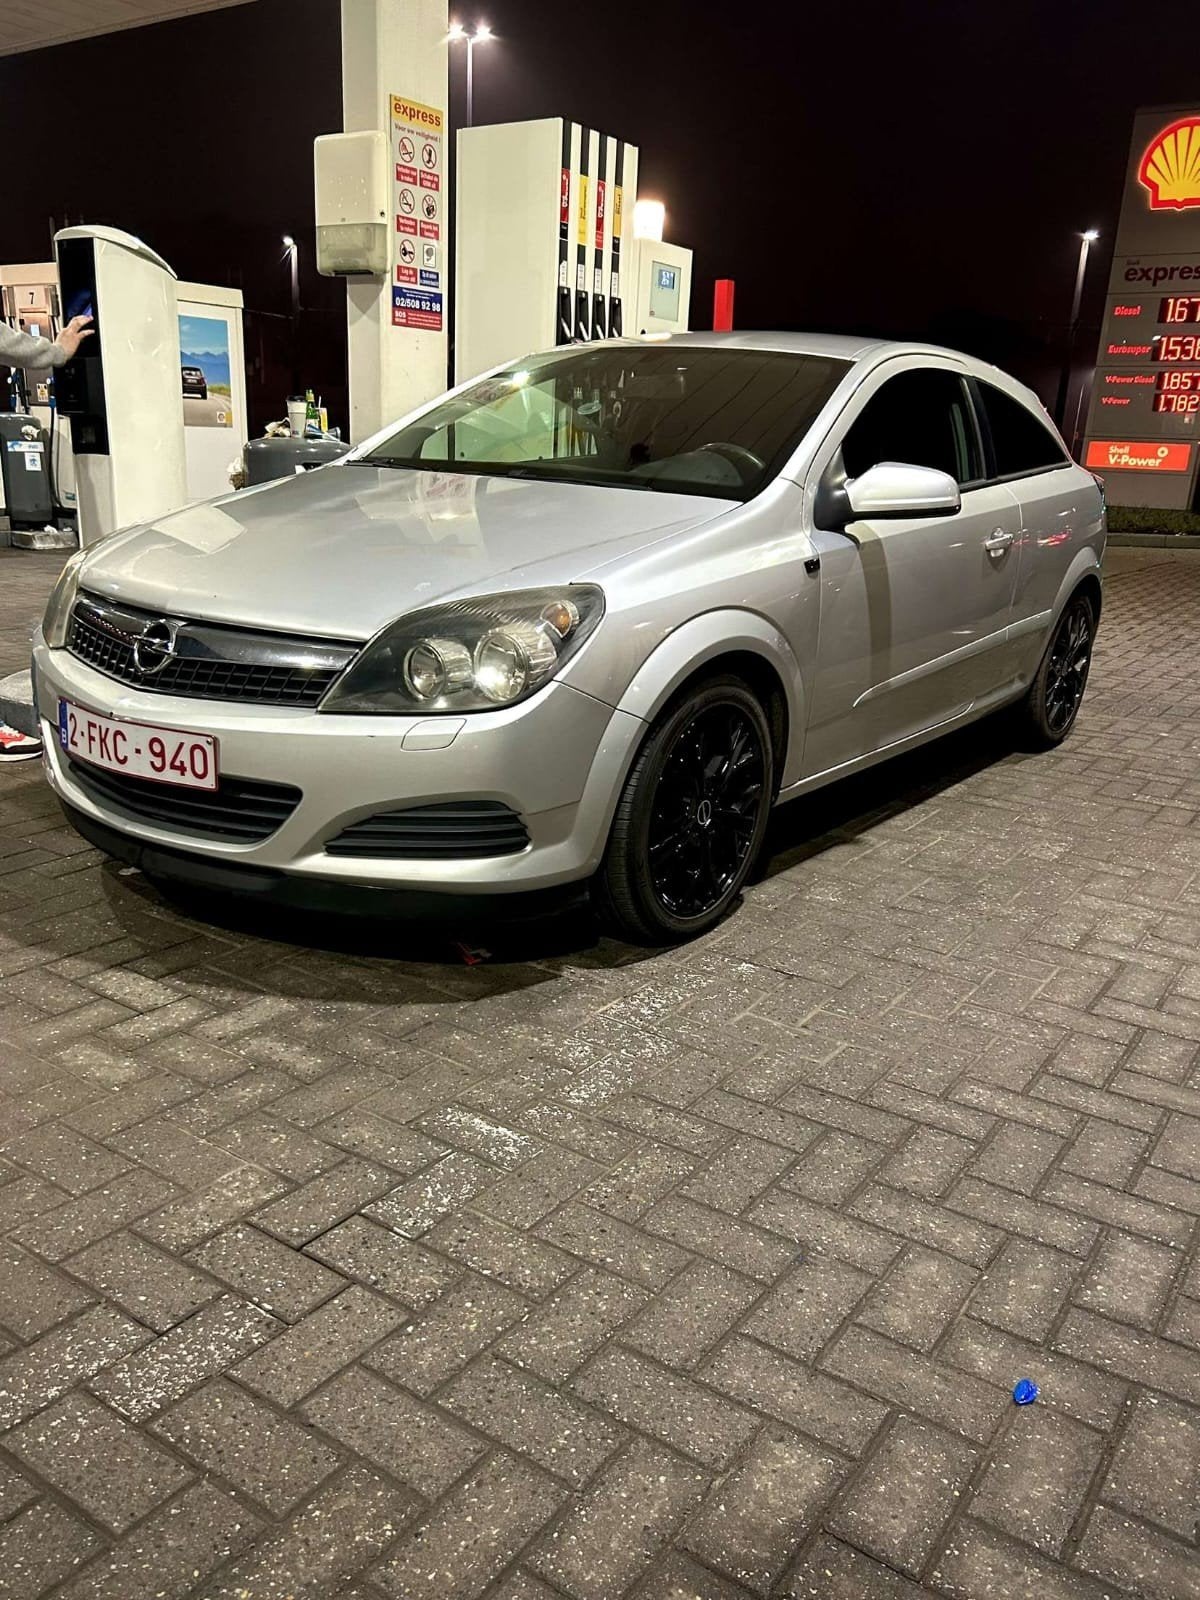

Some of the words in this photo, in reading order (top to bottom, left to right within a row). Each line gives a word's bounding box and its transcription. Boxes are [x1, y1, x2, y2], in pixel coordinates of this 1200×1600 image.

[394, 102, 441, 127] express
[29, 292, 35, 304] 7
[421, 301, 431, 310] 92
[1113, 305, 1142, 316] Diesel
[1108, 344, 1152, 356] Eurosuper
[1158, 394, 1199, 412] 1.782
[1108, 445, 1130, 454] Shell
[1108, 454, 1163, 467] V-Power
[61, 728, 68, 743] B
